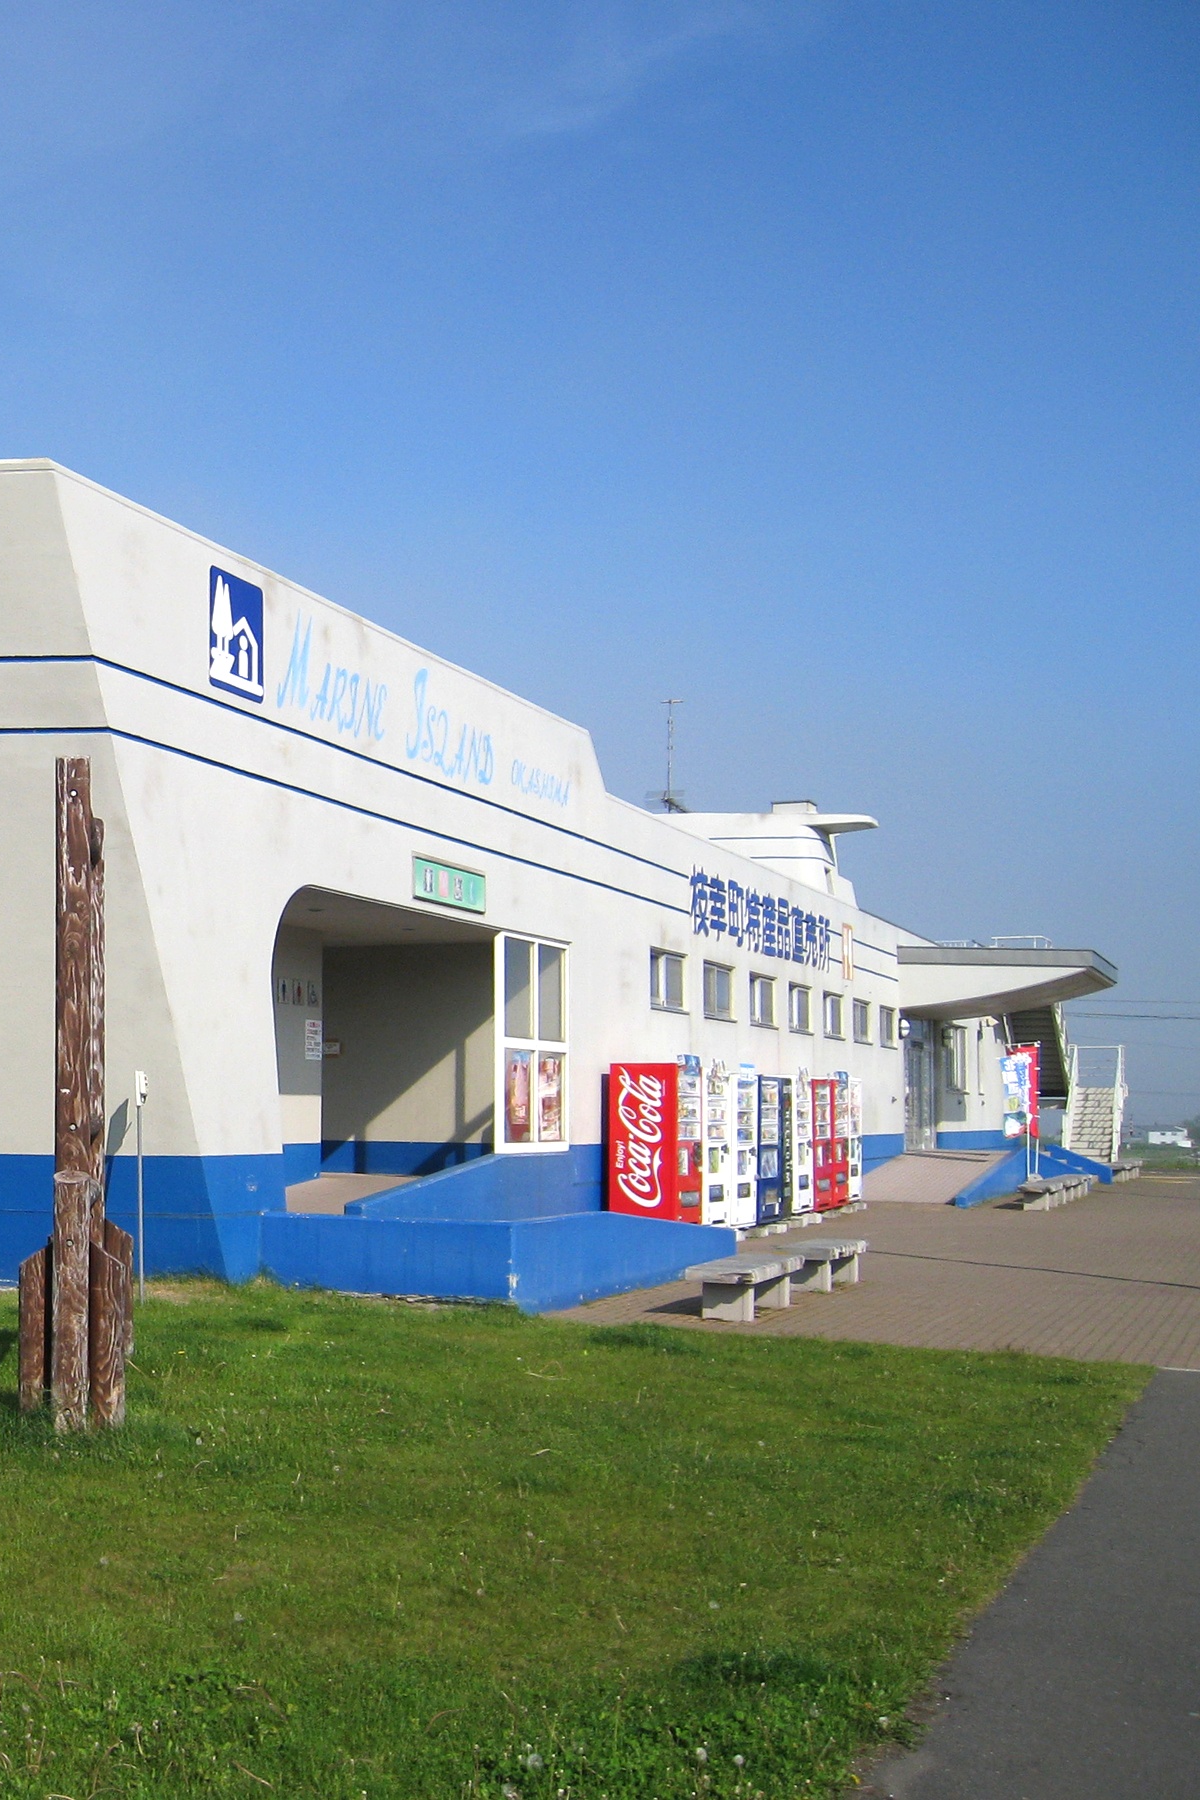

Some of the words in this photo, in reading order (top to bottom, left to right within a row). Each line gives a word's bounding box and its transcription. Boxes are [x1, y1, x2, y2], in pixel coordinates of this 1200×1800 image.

[689, 864, 831, 973] 枝幸町特産品直売所
[615, 1140, 626, 1169] Enjoy!
[618, 1066, 663, 1208] Coca-Cola
